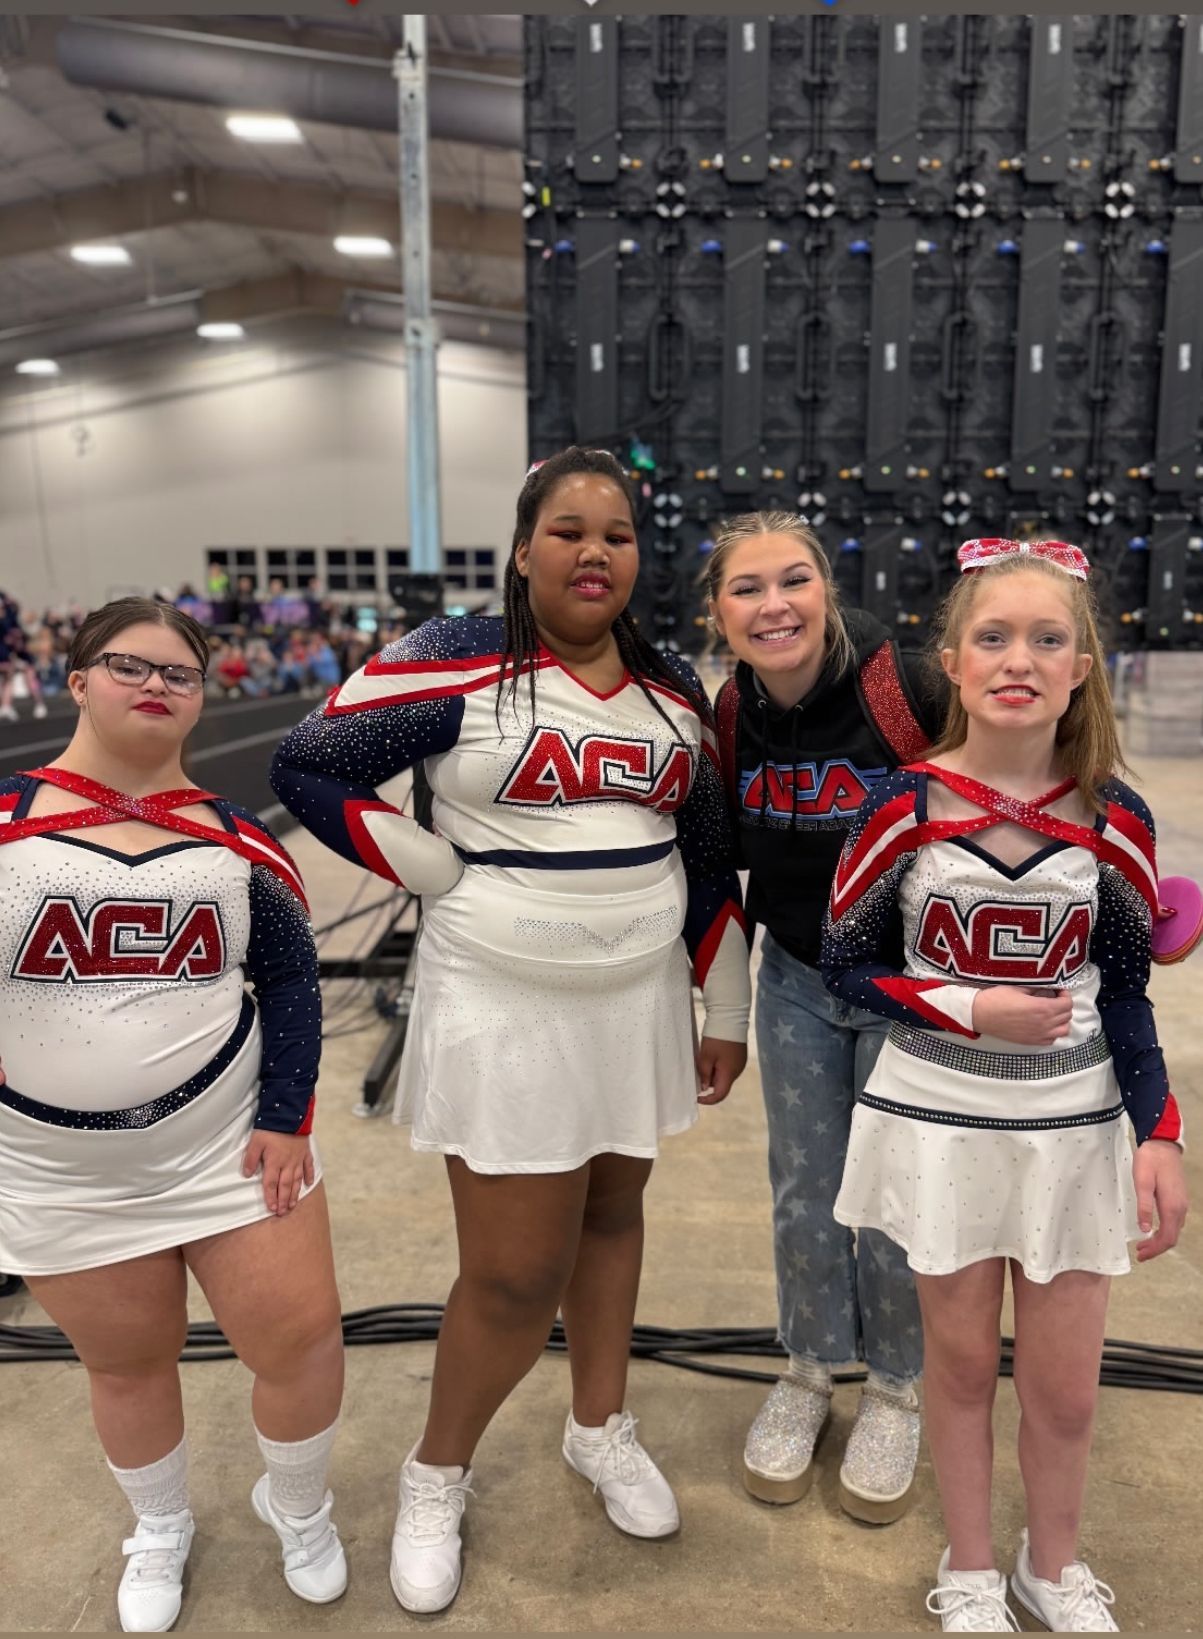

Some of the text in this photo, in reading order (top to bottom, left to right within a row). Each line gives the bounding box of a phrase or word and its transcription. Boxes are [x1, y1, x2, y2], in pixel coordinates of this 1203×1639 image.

[494, 726, 693, 813] ACA
[742, 759, 869, 820] ACA
[10, 896, 226, 984] ACA
[913, 893, 1091, 985] ACA
